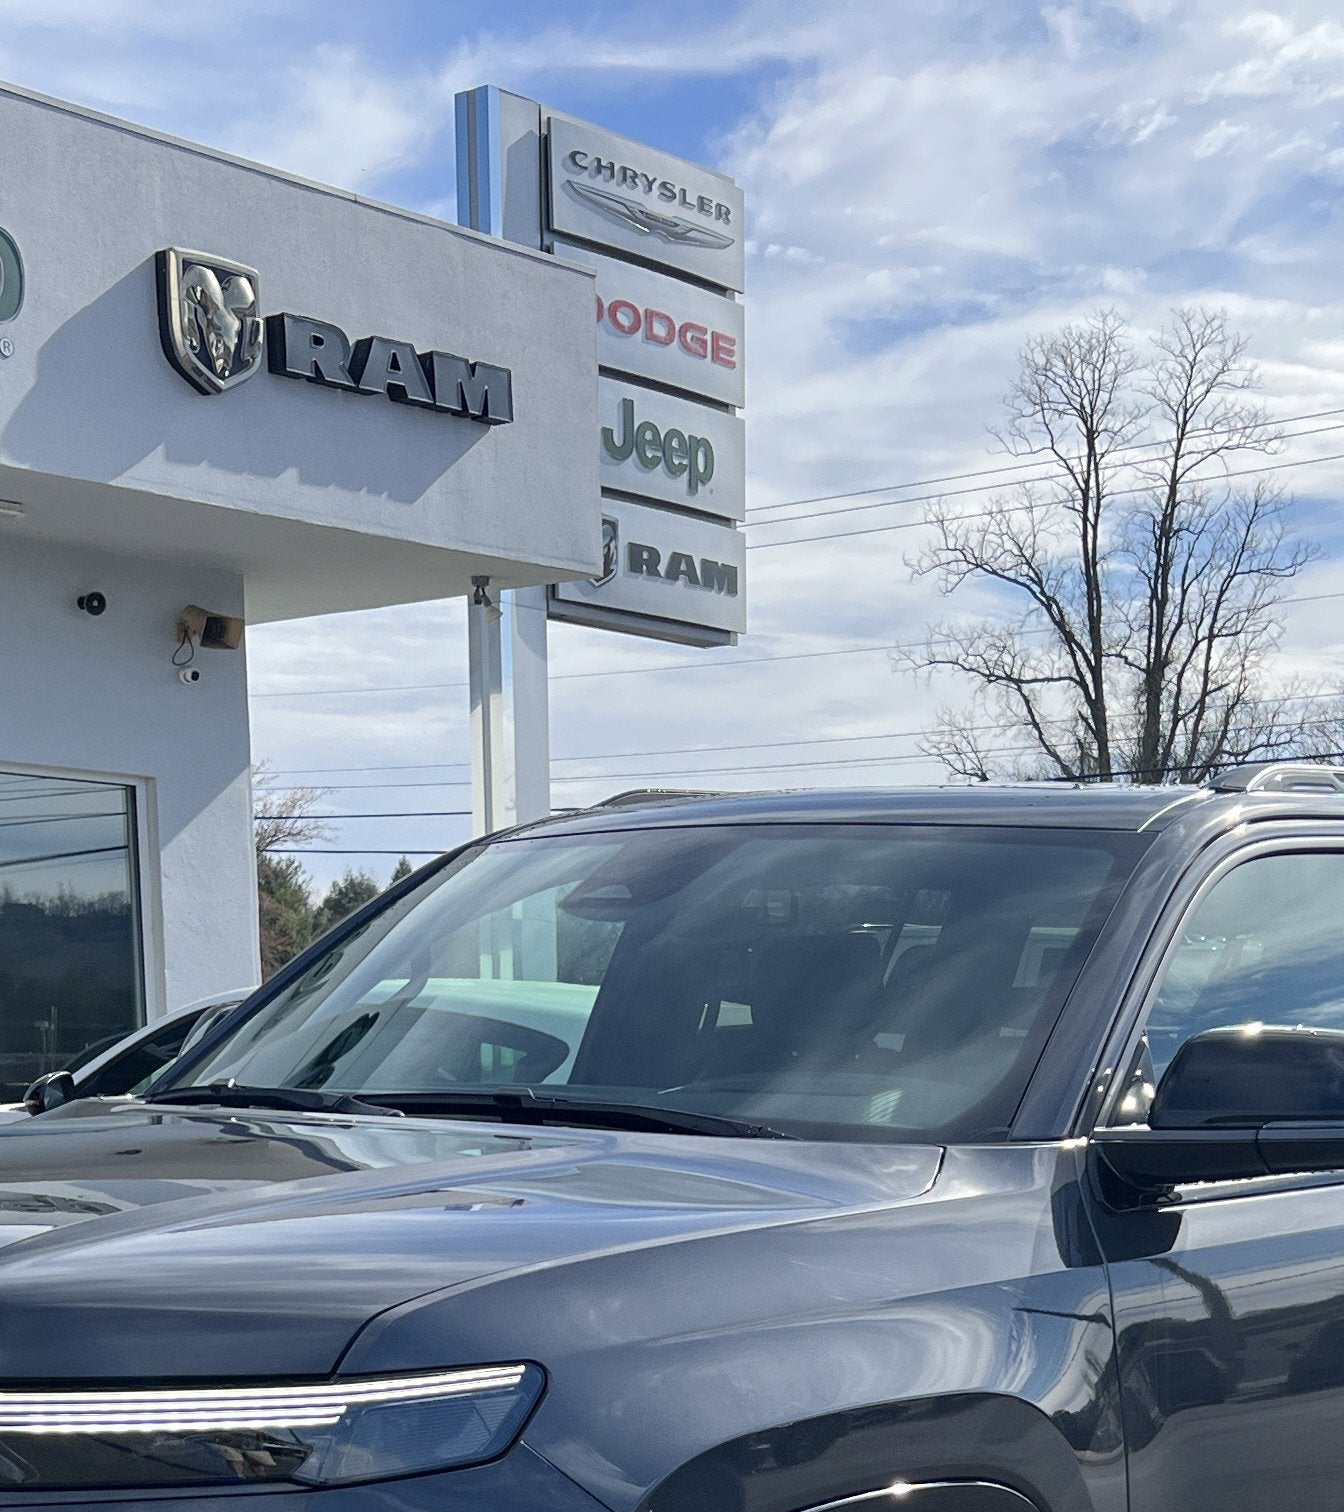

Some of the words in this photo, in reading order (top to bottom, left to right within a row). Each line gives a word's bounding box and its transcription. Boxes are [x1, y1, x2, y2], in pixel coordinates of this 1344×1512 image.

[566, 150, 732, 225] CHRYSLER
[266, 312, 514, 425] RAM
[597, 294, 737, 369] ODGE
[601, 398, 714, 496] Jeep
[626, 541, 738, 597] RAM
